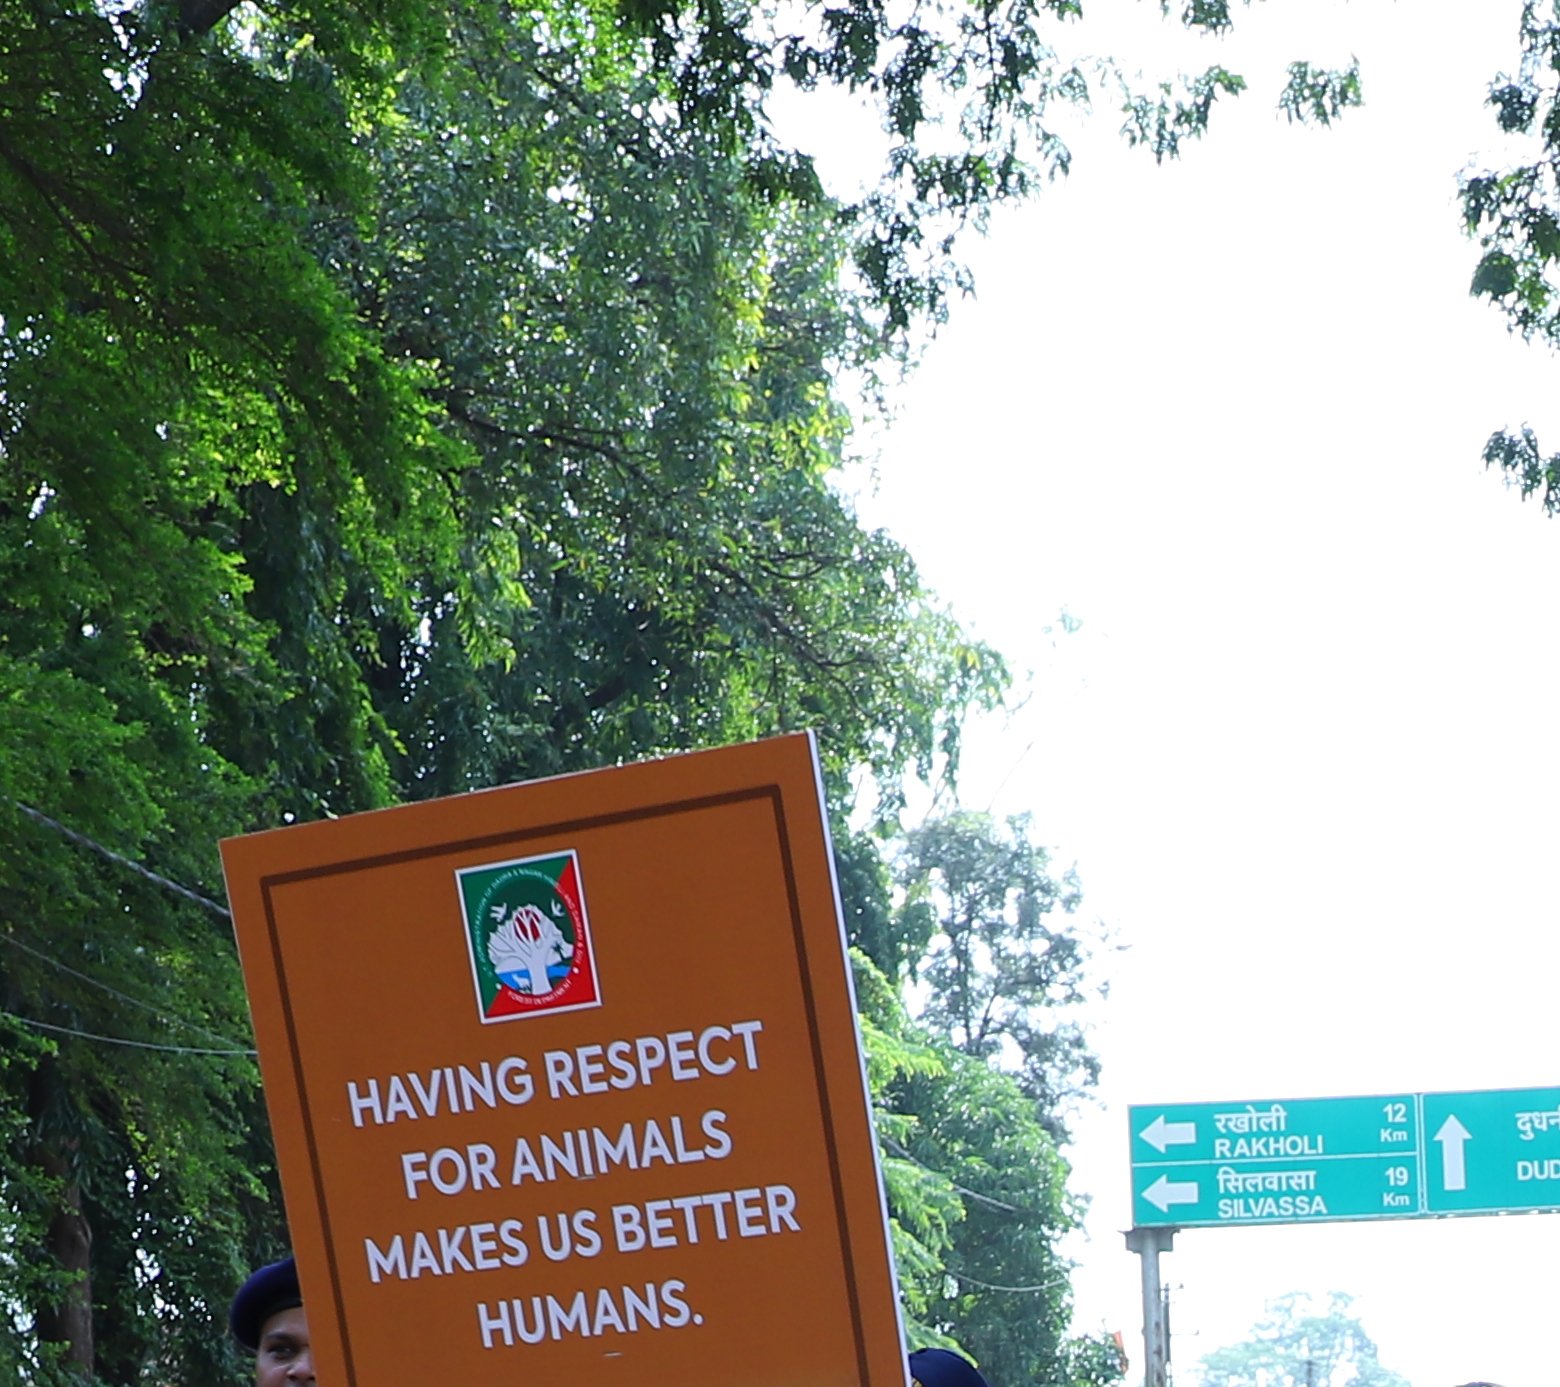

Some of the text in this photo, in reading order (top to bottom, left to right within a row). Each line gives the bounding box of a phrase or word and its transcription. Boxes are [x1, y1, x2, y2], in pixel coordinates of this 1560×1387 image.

[347, 1020, 763, 1128] HAVING RESPECT
[1214, 1105, 1287, 1134] रखोली
[1382, 1103, 1407, 1123] 12
[1214, 1135, 1324, 1158] RAKHOLI
[1380, 1128, 1408, 1142] Km
[401, 1109, 733, 1200] FOR ANIMALS
[1216, 1166, 1317, 1194] सिलवासा
[1385, 1167, 1409, 1186] 19
[1218, 1195, 1328, 1219] SILVASSA
[1382, 1192, 1410, 1207] Km
[364, 1184, 802, 1283] MAKES US BETTER
[477, 1279, 704, 1348] HUMANS.
